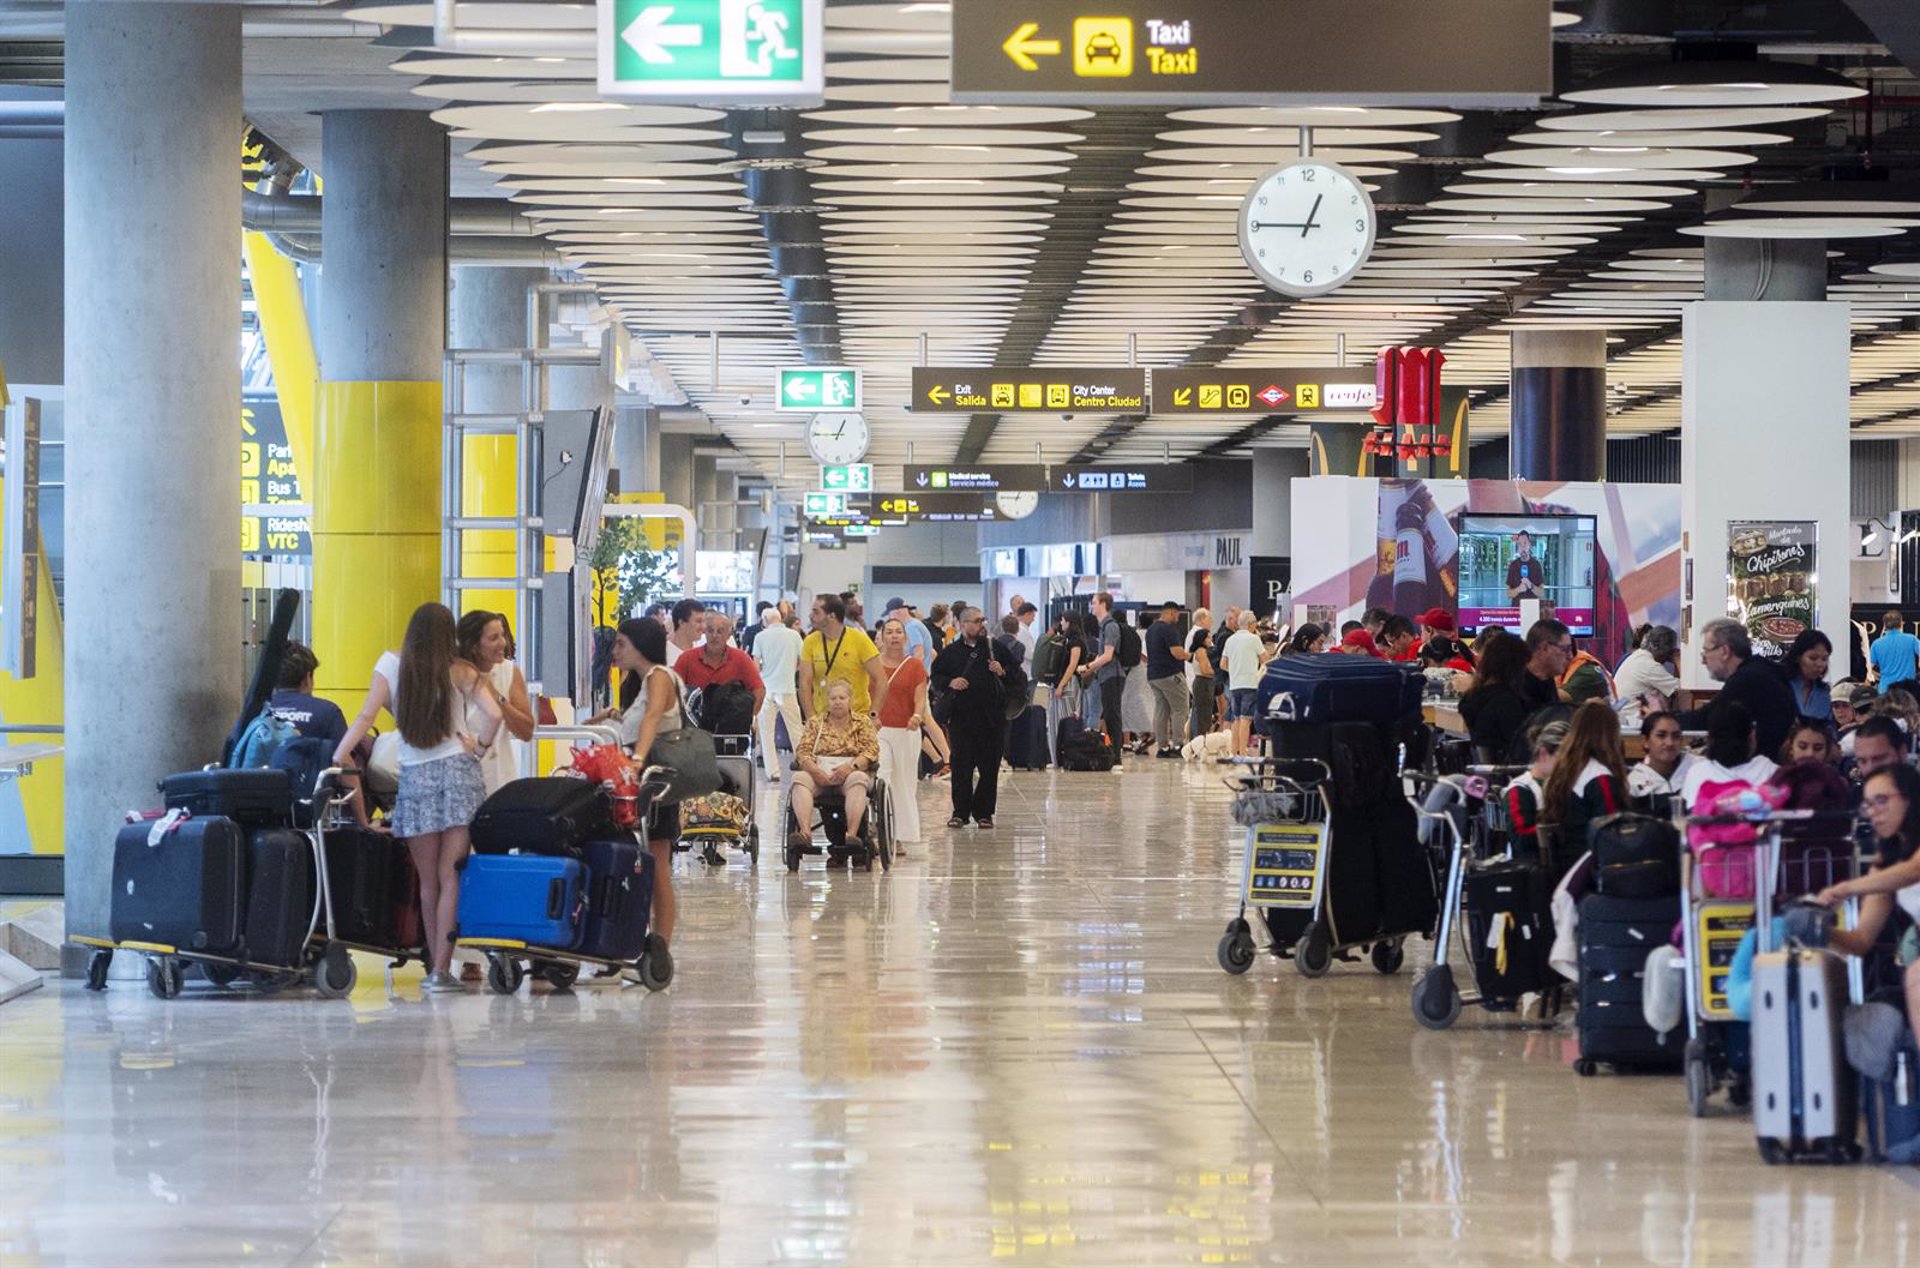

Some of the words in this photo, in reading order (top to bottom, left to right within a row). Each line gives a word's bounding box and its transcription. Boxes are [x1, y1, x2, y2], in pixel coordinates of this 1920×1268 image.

[1146, 20, 1191, 45] Taxi
[1146, 47, 1198, 75] Taxi
[1301, 168, 1316, 182] 12
[1351, 195, 1358, 205] 2
[1250, 219, 1260, 233] 9
[1355, 219, 1365, 233] 3
[1351, 247, 1358, 256] 4
[1303, 269, 1313, 284] 6
[1332, 265, 1339, 275] 5
[955, 384, 972, 395] Exit
[1073, 385, 1088, 396] City
[1090, 386, 1116, 396] Center
[955, 395, 986, 407] Salida
[1074, 396, 1106, 407] Centro
[1108, 396, 1141, 407] Ciudad
[268, 481, 291, 494] Bus
[267, 518, 310, 532] Ridesh
[267, 534, 299, 549] VTC
[1216, 537, 1242, 566] PAUL
